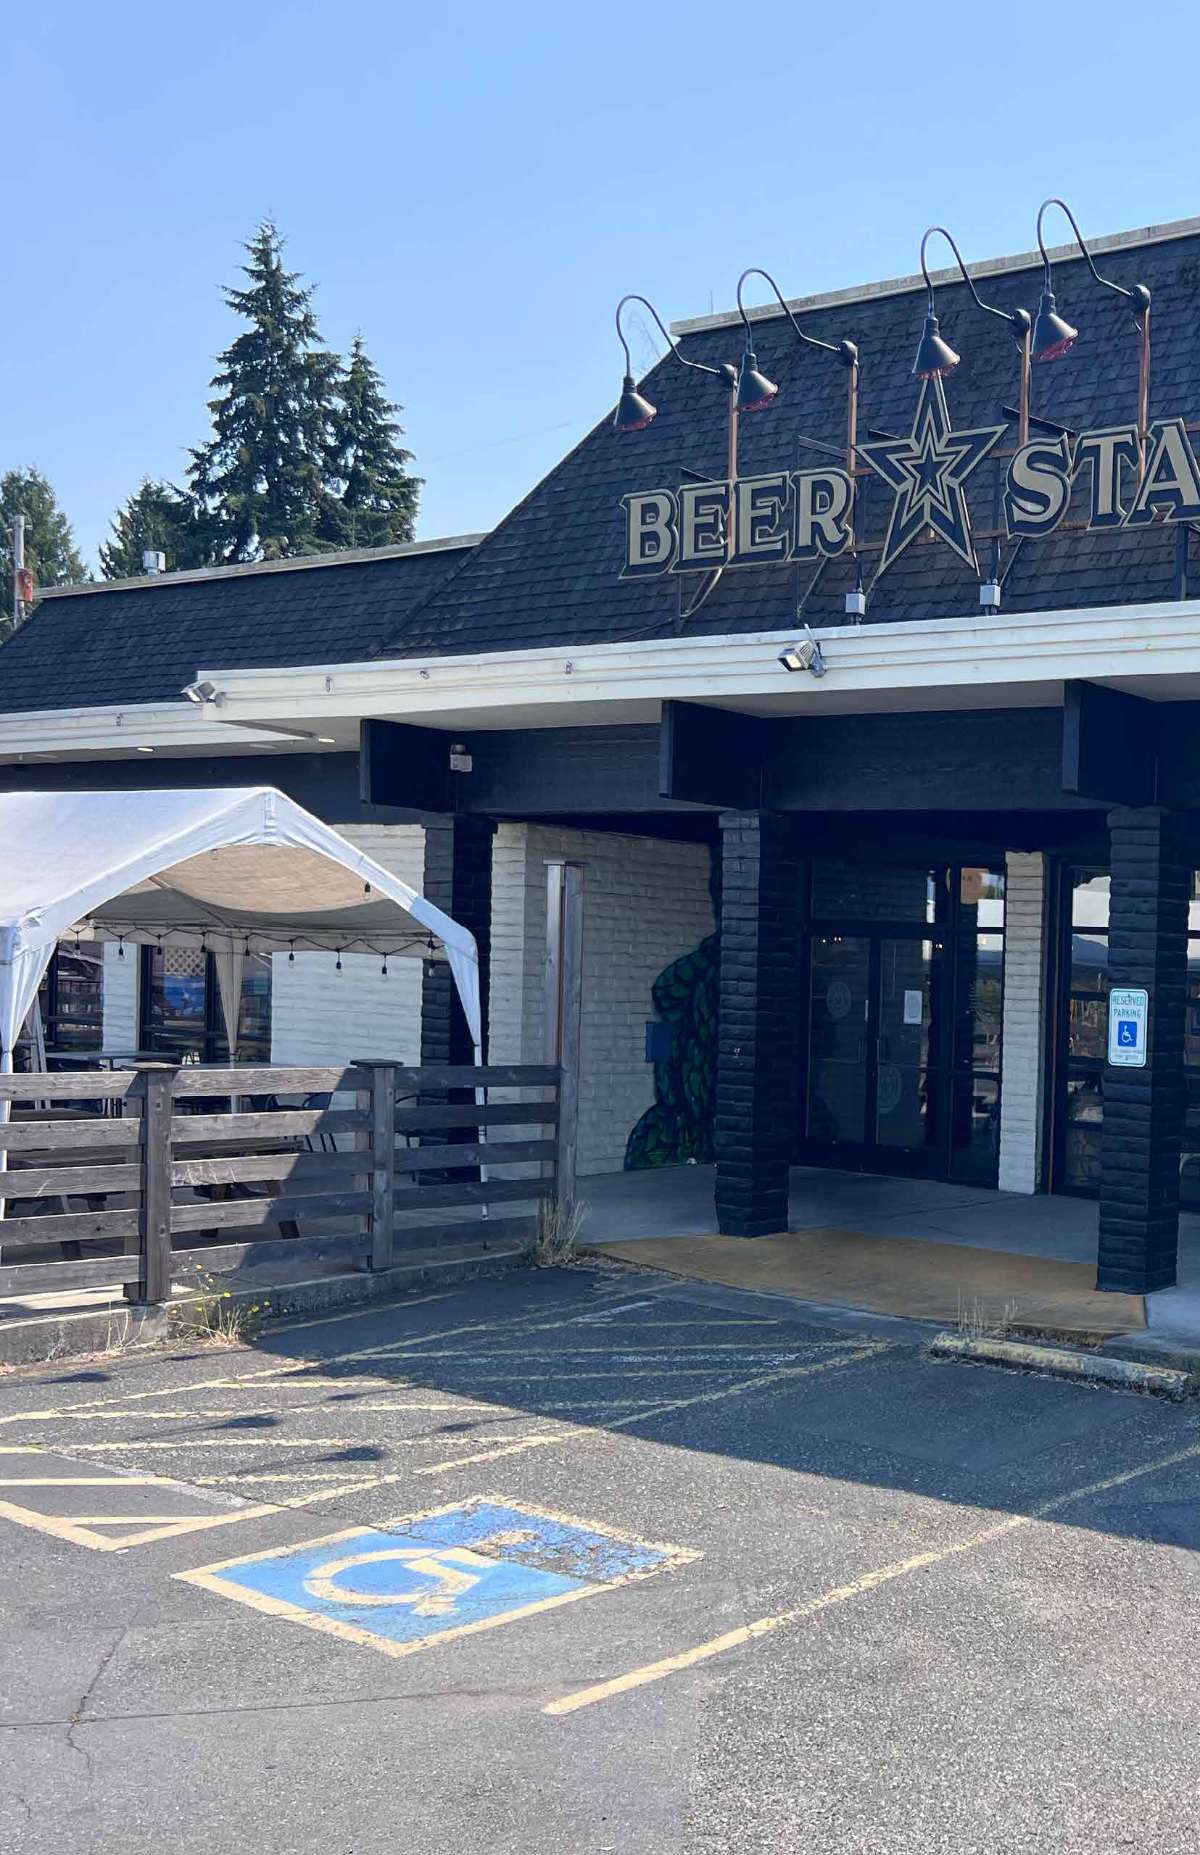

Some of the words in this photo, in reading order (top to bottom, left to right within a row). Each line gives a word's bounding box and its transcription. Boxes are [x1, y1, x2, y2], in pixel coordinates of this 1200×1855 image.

[618, 467, 855, 580] BEER
[1112, 995, 1145, 1006] RESERVED
[1113, 1008, 1142, 1018] PARKING
